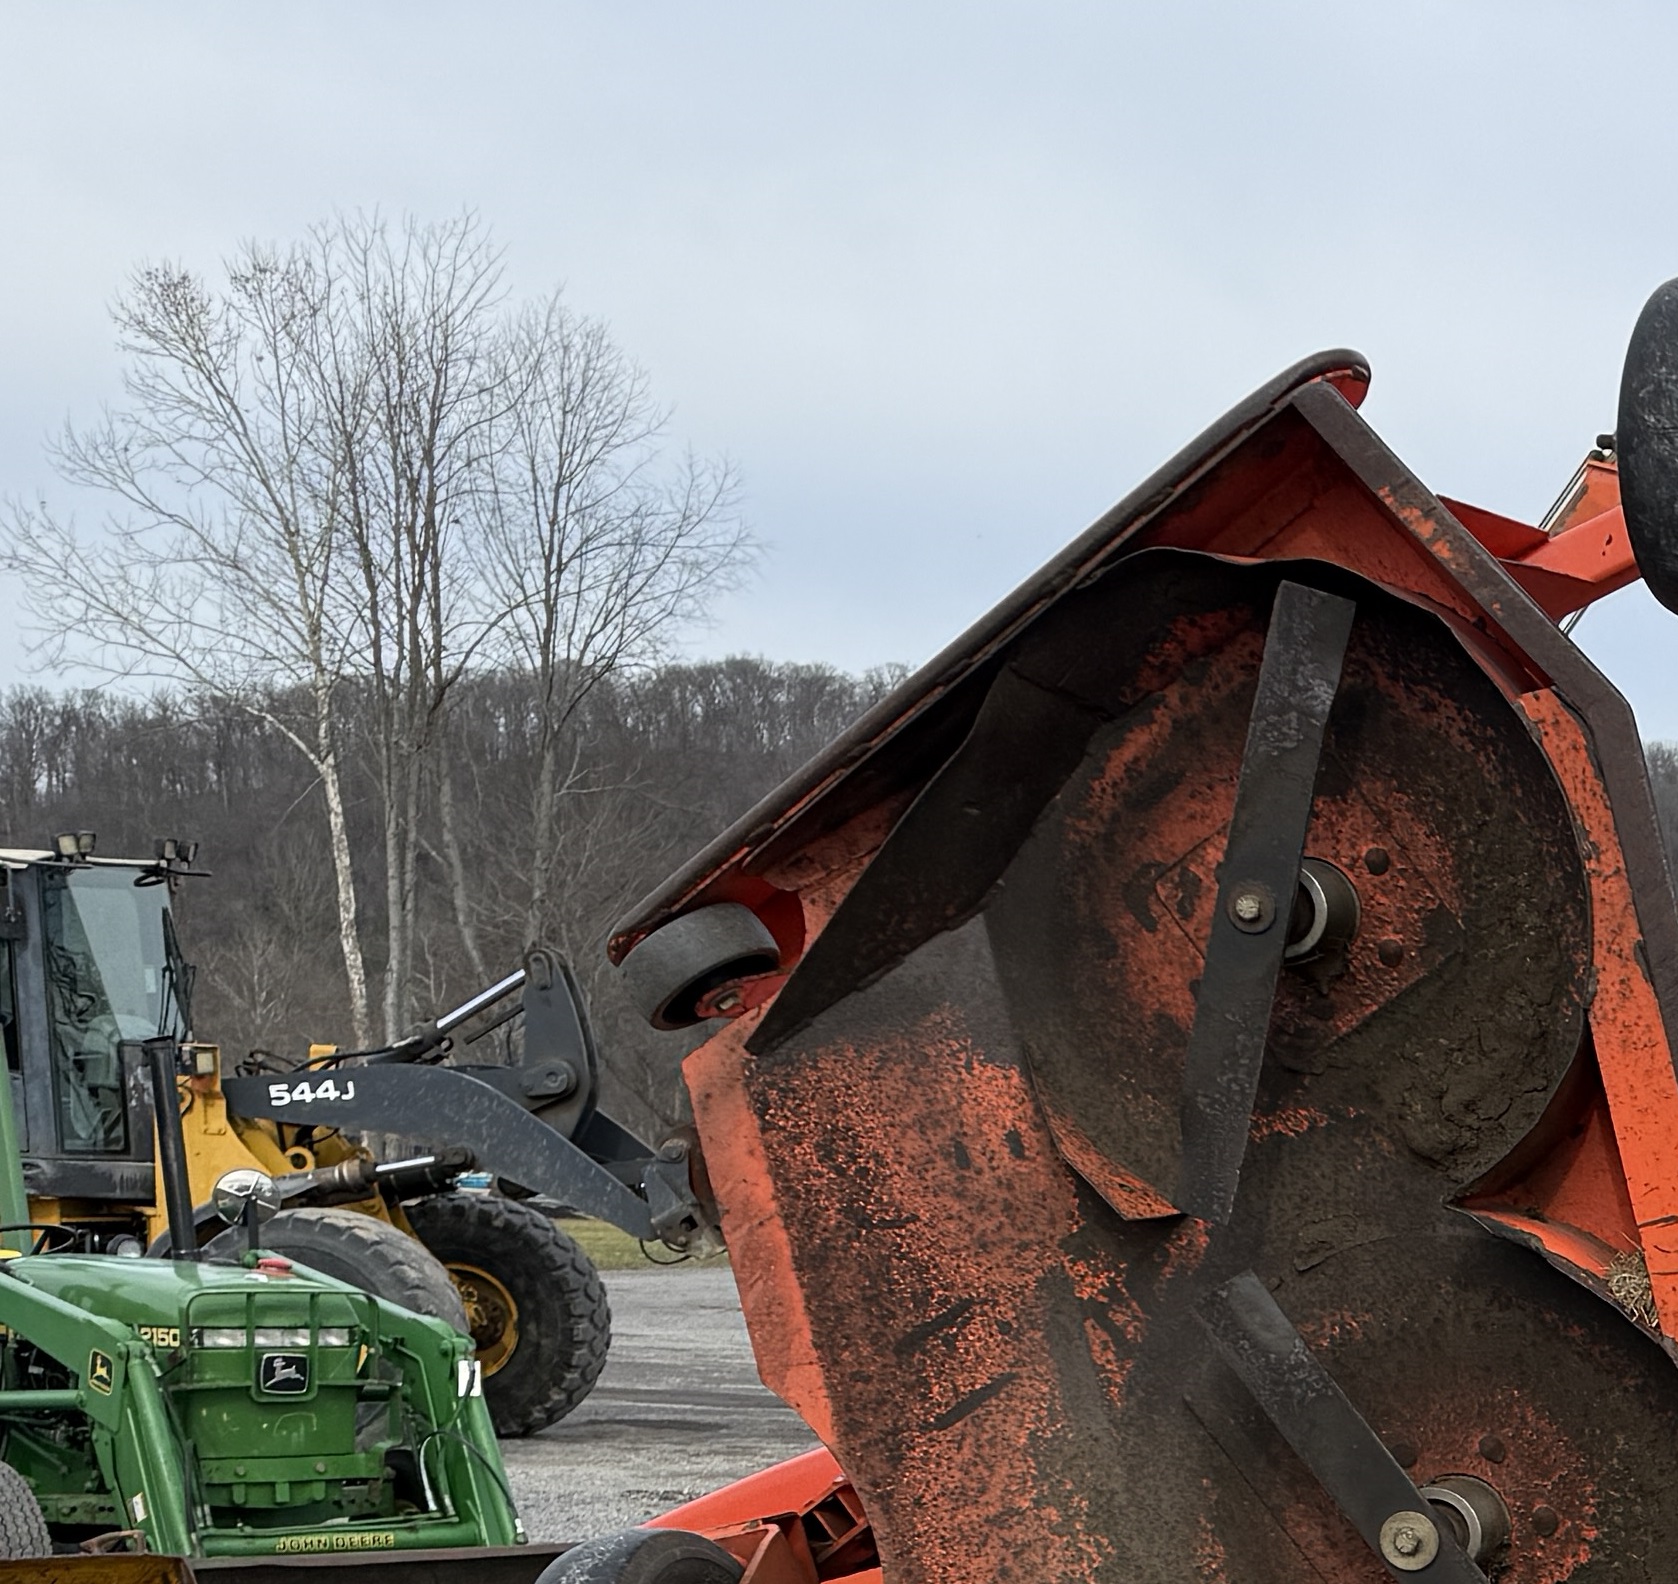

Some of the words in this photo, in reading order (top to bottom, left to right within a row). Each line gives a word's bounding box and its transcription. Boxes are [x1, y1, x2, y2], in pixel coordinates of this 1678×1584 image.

[268, 1079, 355, 1107] 544J
[139, 1327, 181, 1347] 2150
[275, 1534, 329, 1552] JOHN
[333, 1533, 395, 1550] DEERE
